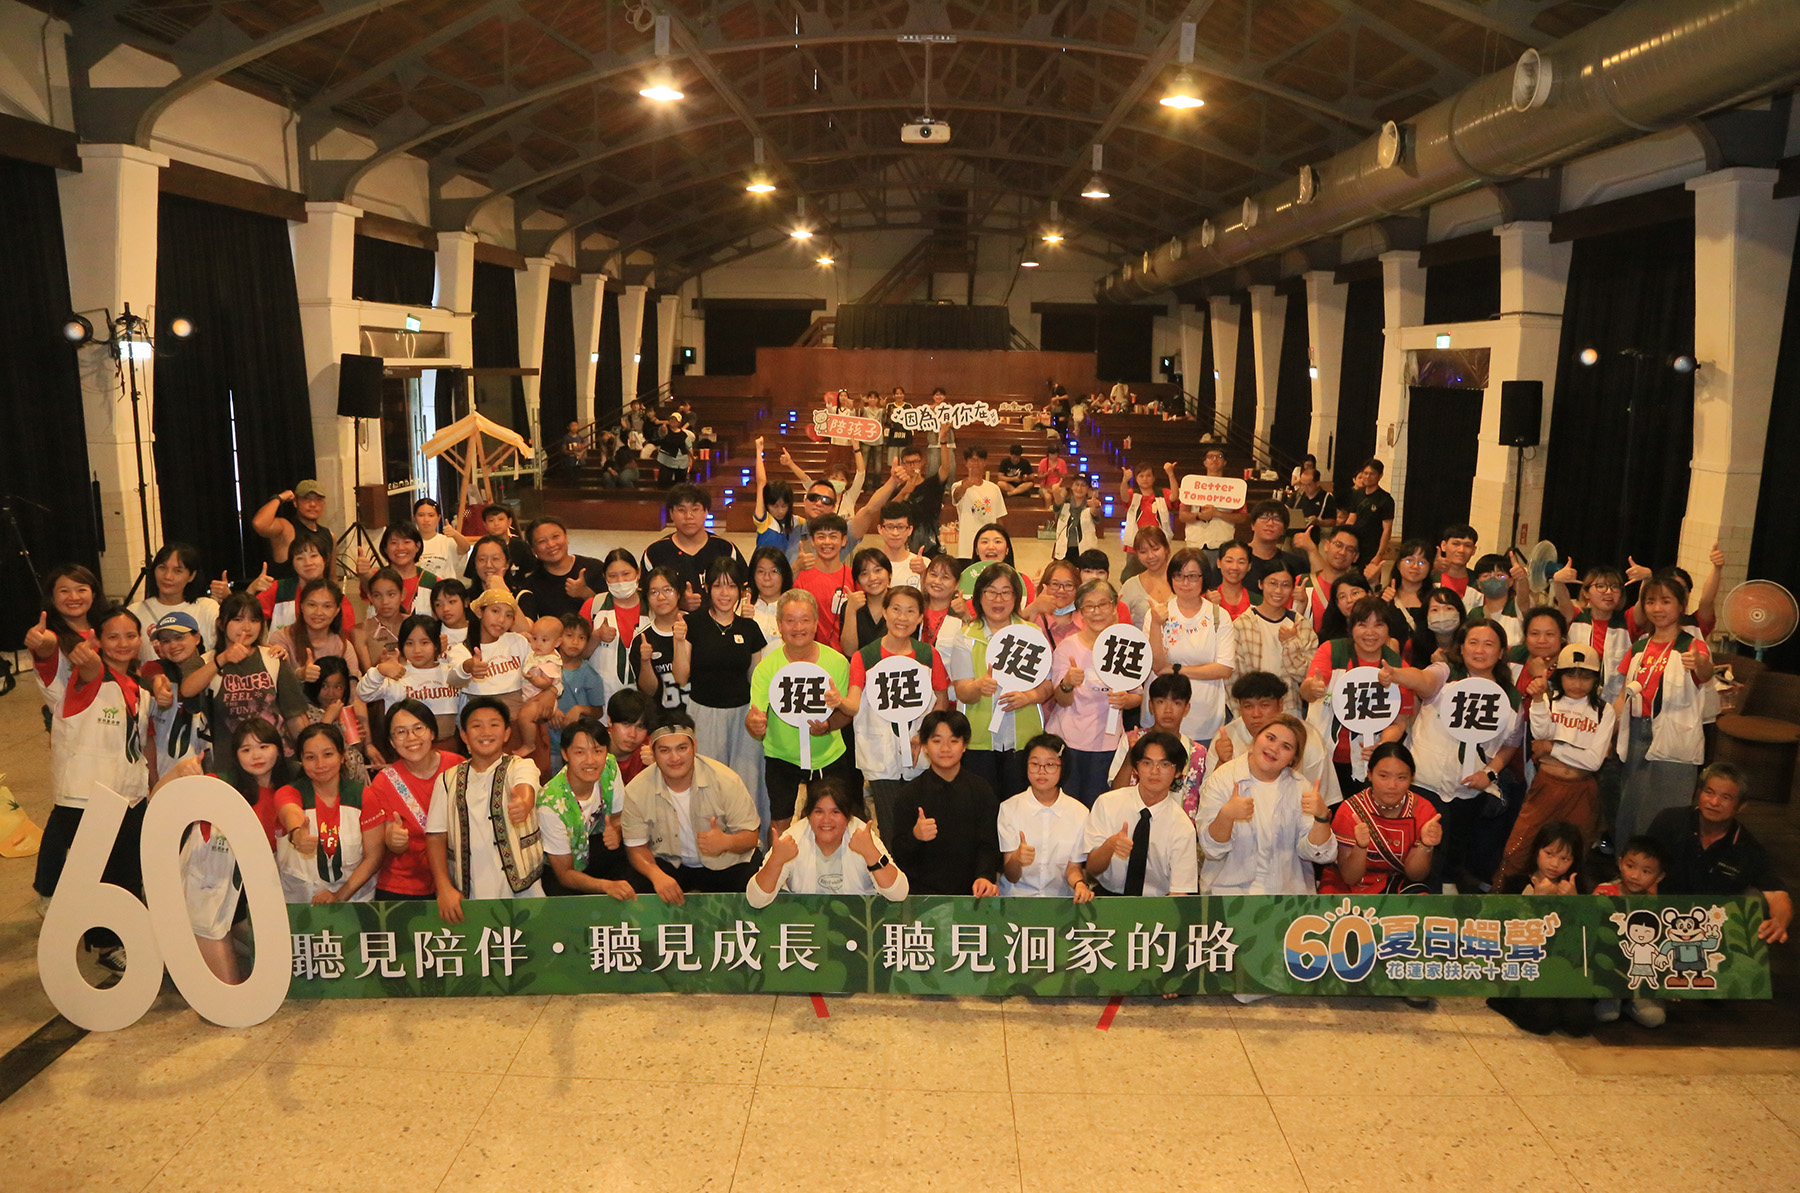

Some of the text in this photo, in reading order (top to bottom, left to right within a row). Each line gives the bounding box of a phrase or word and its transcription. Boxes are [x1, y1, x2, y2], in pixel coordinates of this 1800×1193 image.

[829, 418, 877, 438] 陪孩子
[905, 404, 988, 429] 因為有你在
[1183, 491, 1241, 504] Tomorrow
[1194, 481, 1234, 492] Better
[992, 634, 1047, 684] 挺
[1100, 634, 1146, 680] 挺
[223, 692, 253, 702] FEEL
[778, 676, 828, 714] 挺
[875, 669, 923, 711] 挺
[1342, 682, 1392, 721] 挺
[1449, 691, 1501, 732] 挺
[38, 775, 292, 1032] 60
[1385, 961, 1540, 981] 花蓮家扶六十週年
